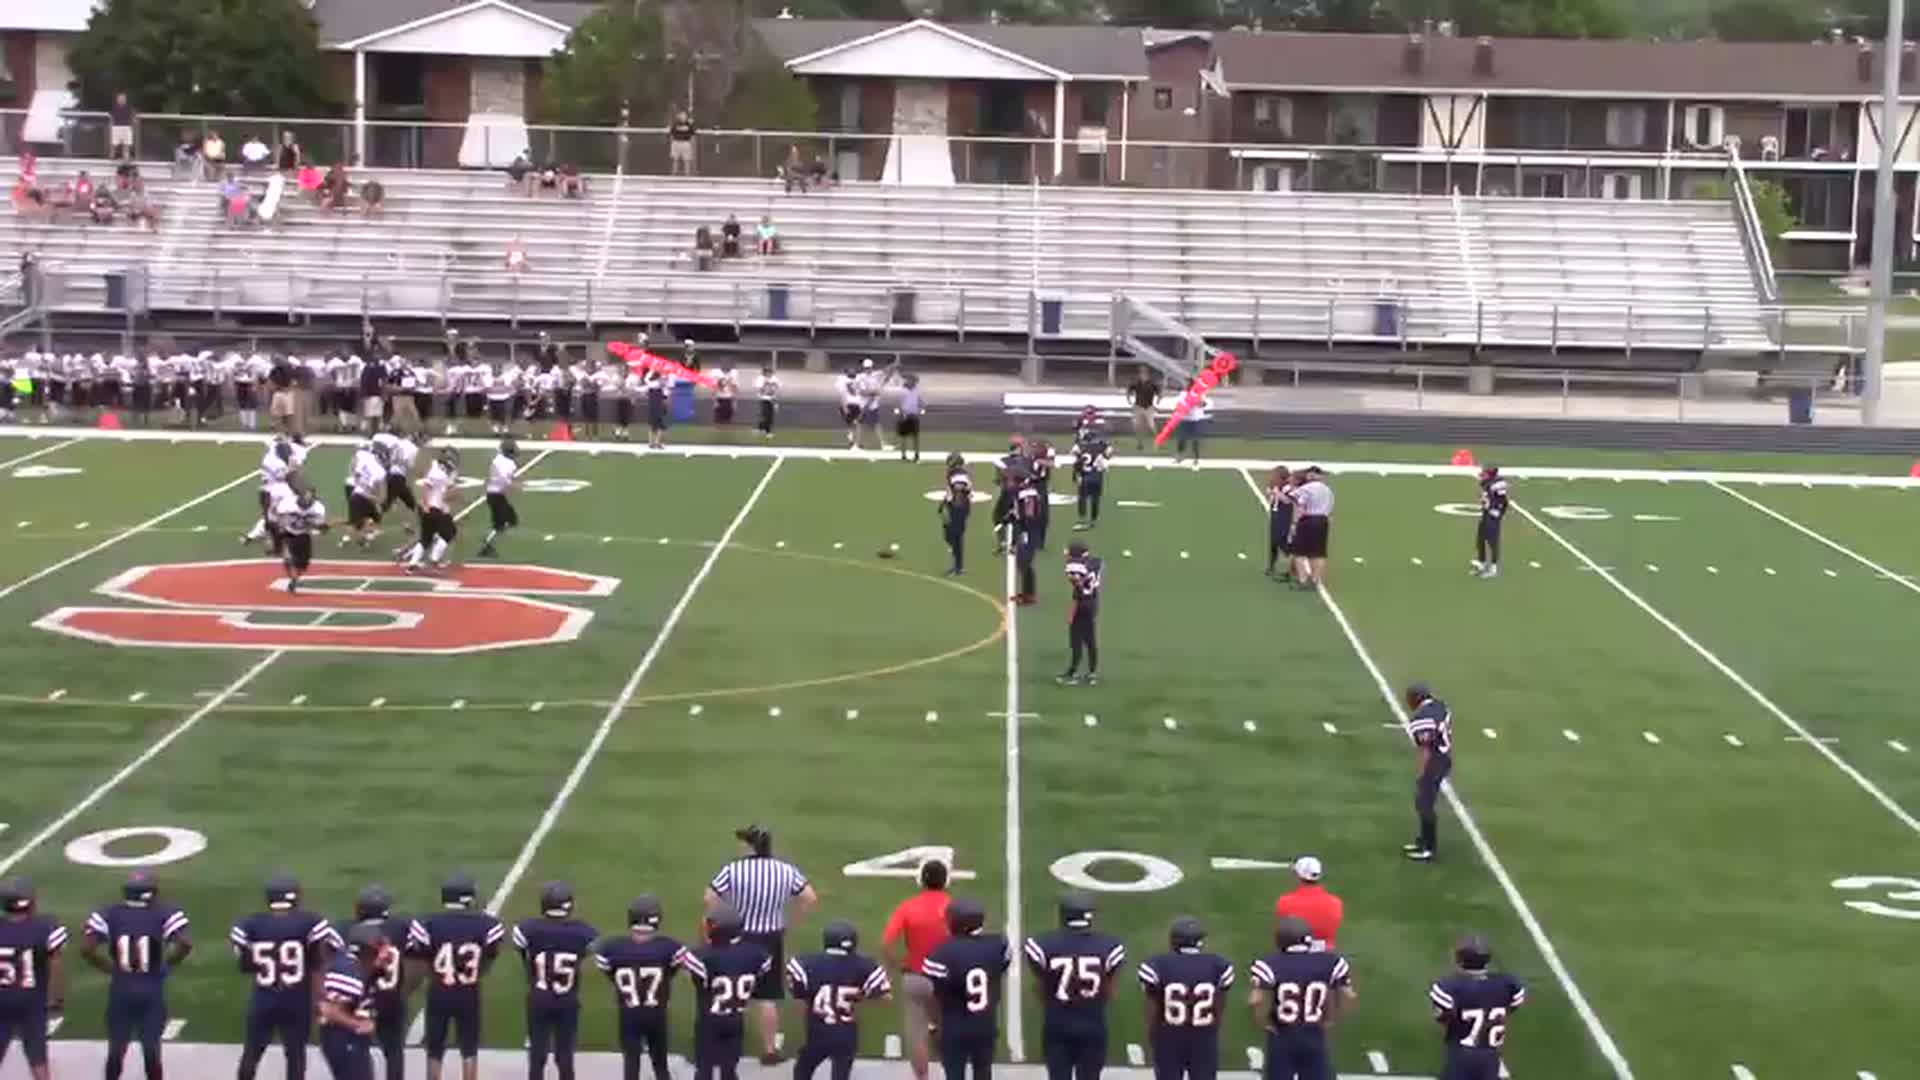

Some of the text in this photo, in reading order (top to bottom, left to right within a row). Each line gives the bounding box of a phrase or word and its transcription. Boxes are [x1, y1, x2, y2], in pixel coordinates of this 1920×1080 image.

[32, 558, 622, 655] S
[0, 946, 36, 988] 51
[117, 934, 150, 973] 11
[252, 941, 304, 986] 59
[376, 945, 401, 990] 3
[433, 942, 481, 986] 43
[535, 951, 578, 995] 15
[615, 957, 663, 1008] 97
[711, 974, 757, 1014] 29
[966, 967, 988, 1012] 9
[1050, 956, 1101, 1001] 75
[813, 984, 860, 1024] 45
[1164, 982, 1216, 1026] 62
[1277, 981, 1328, 1023] 60
[1460, 1007, 1506, 1047] 72
